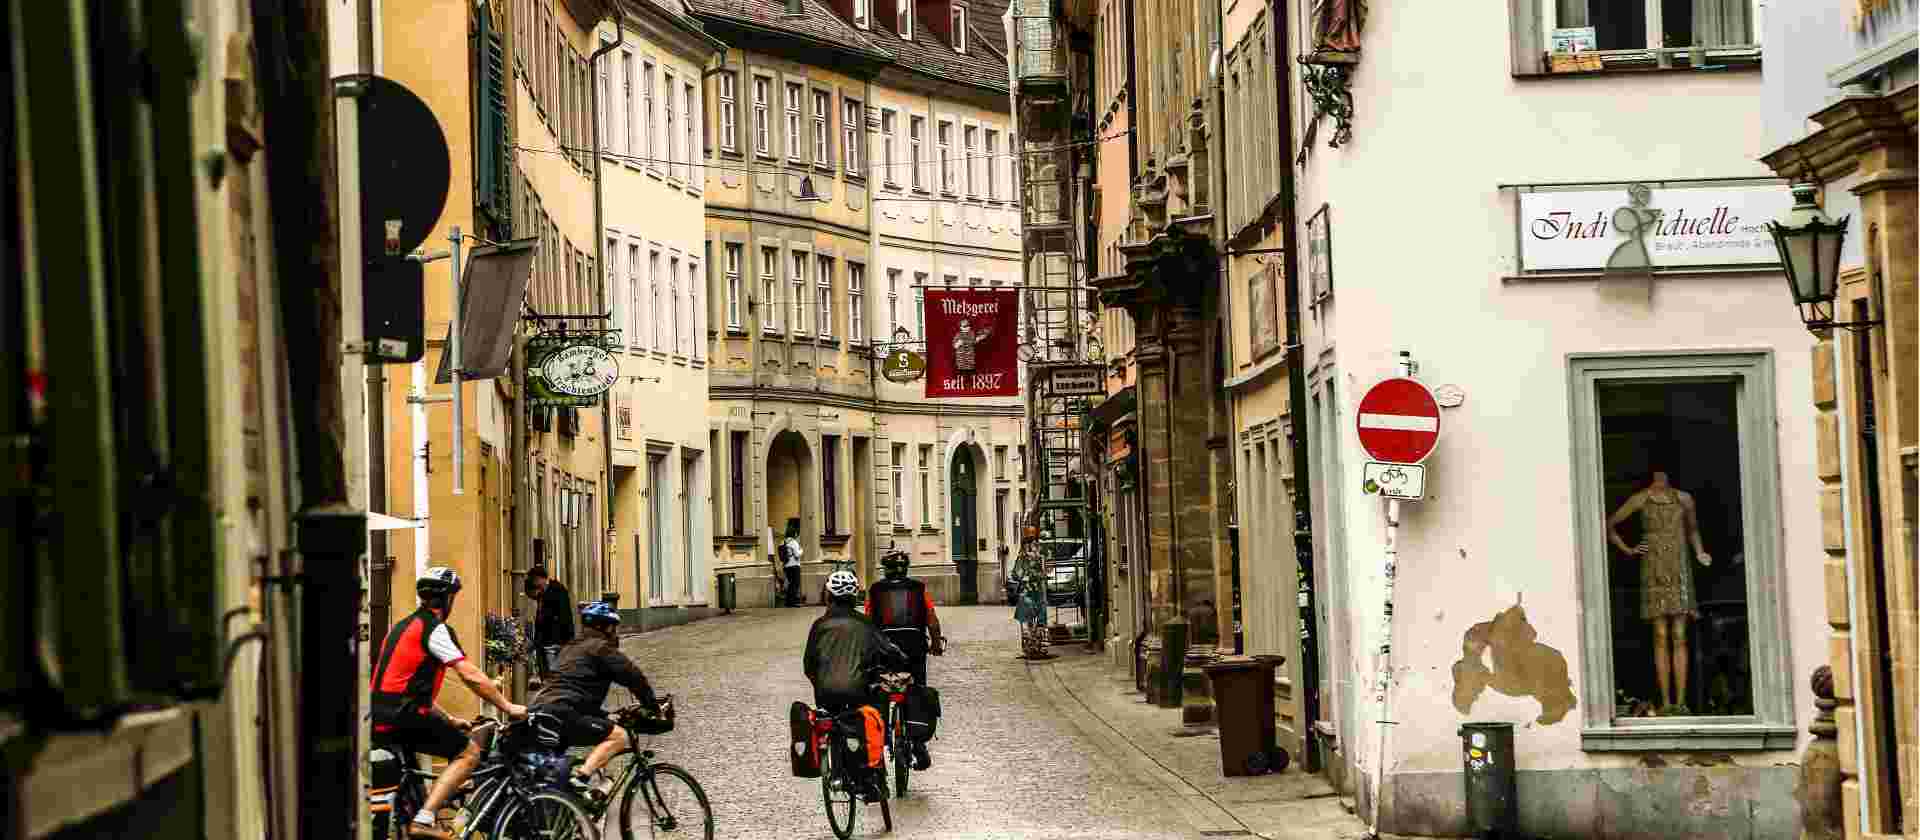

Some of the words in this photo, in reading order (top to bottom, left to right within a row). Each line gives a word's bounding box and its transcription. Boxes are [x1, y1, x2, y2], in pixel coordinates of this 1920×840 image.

[1531, 206, 1740, 240] Indiiduelle
[941, 297, 999, 318] Metzgerei
[943, 375, 965, 390] seit
